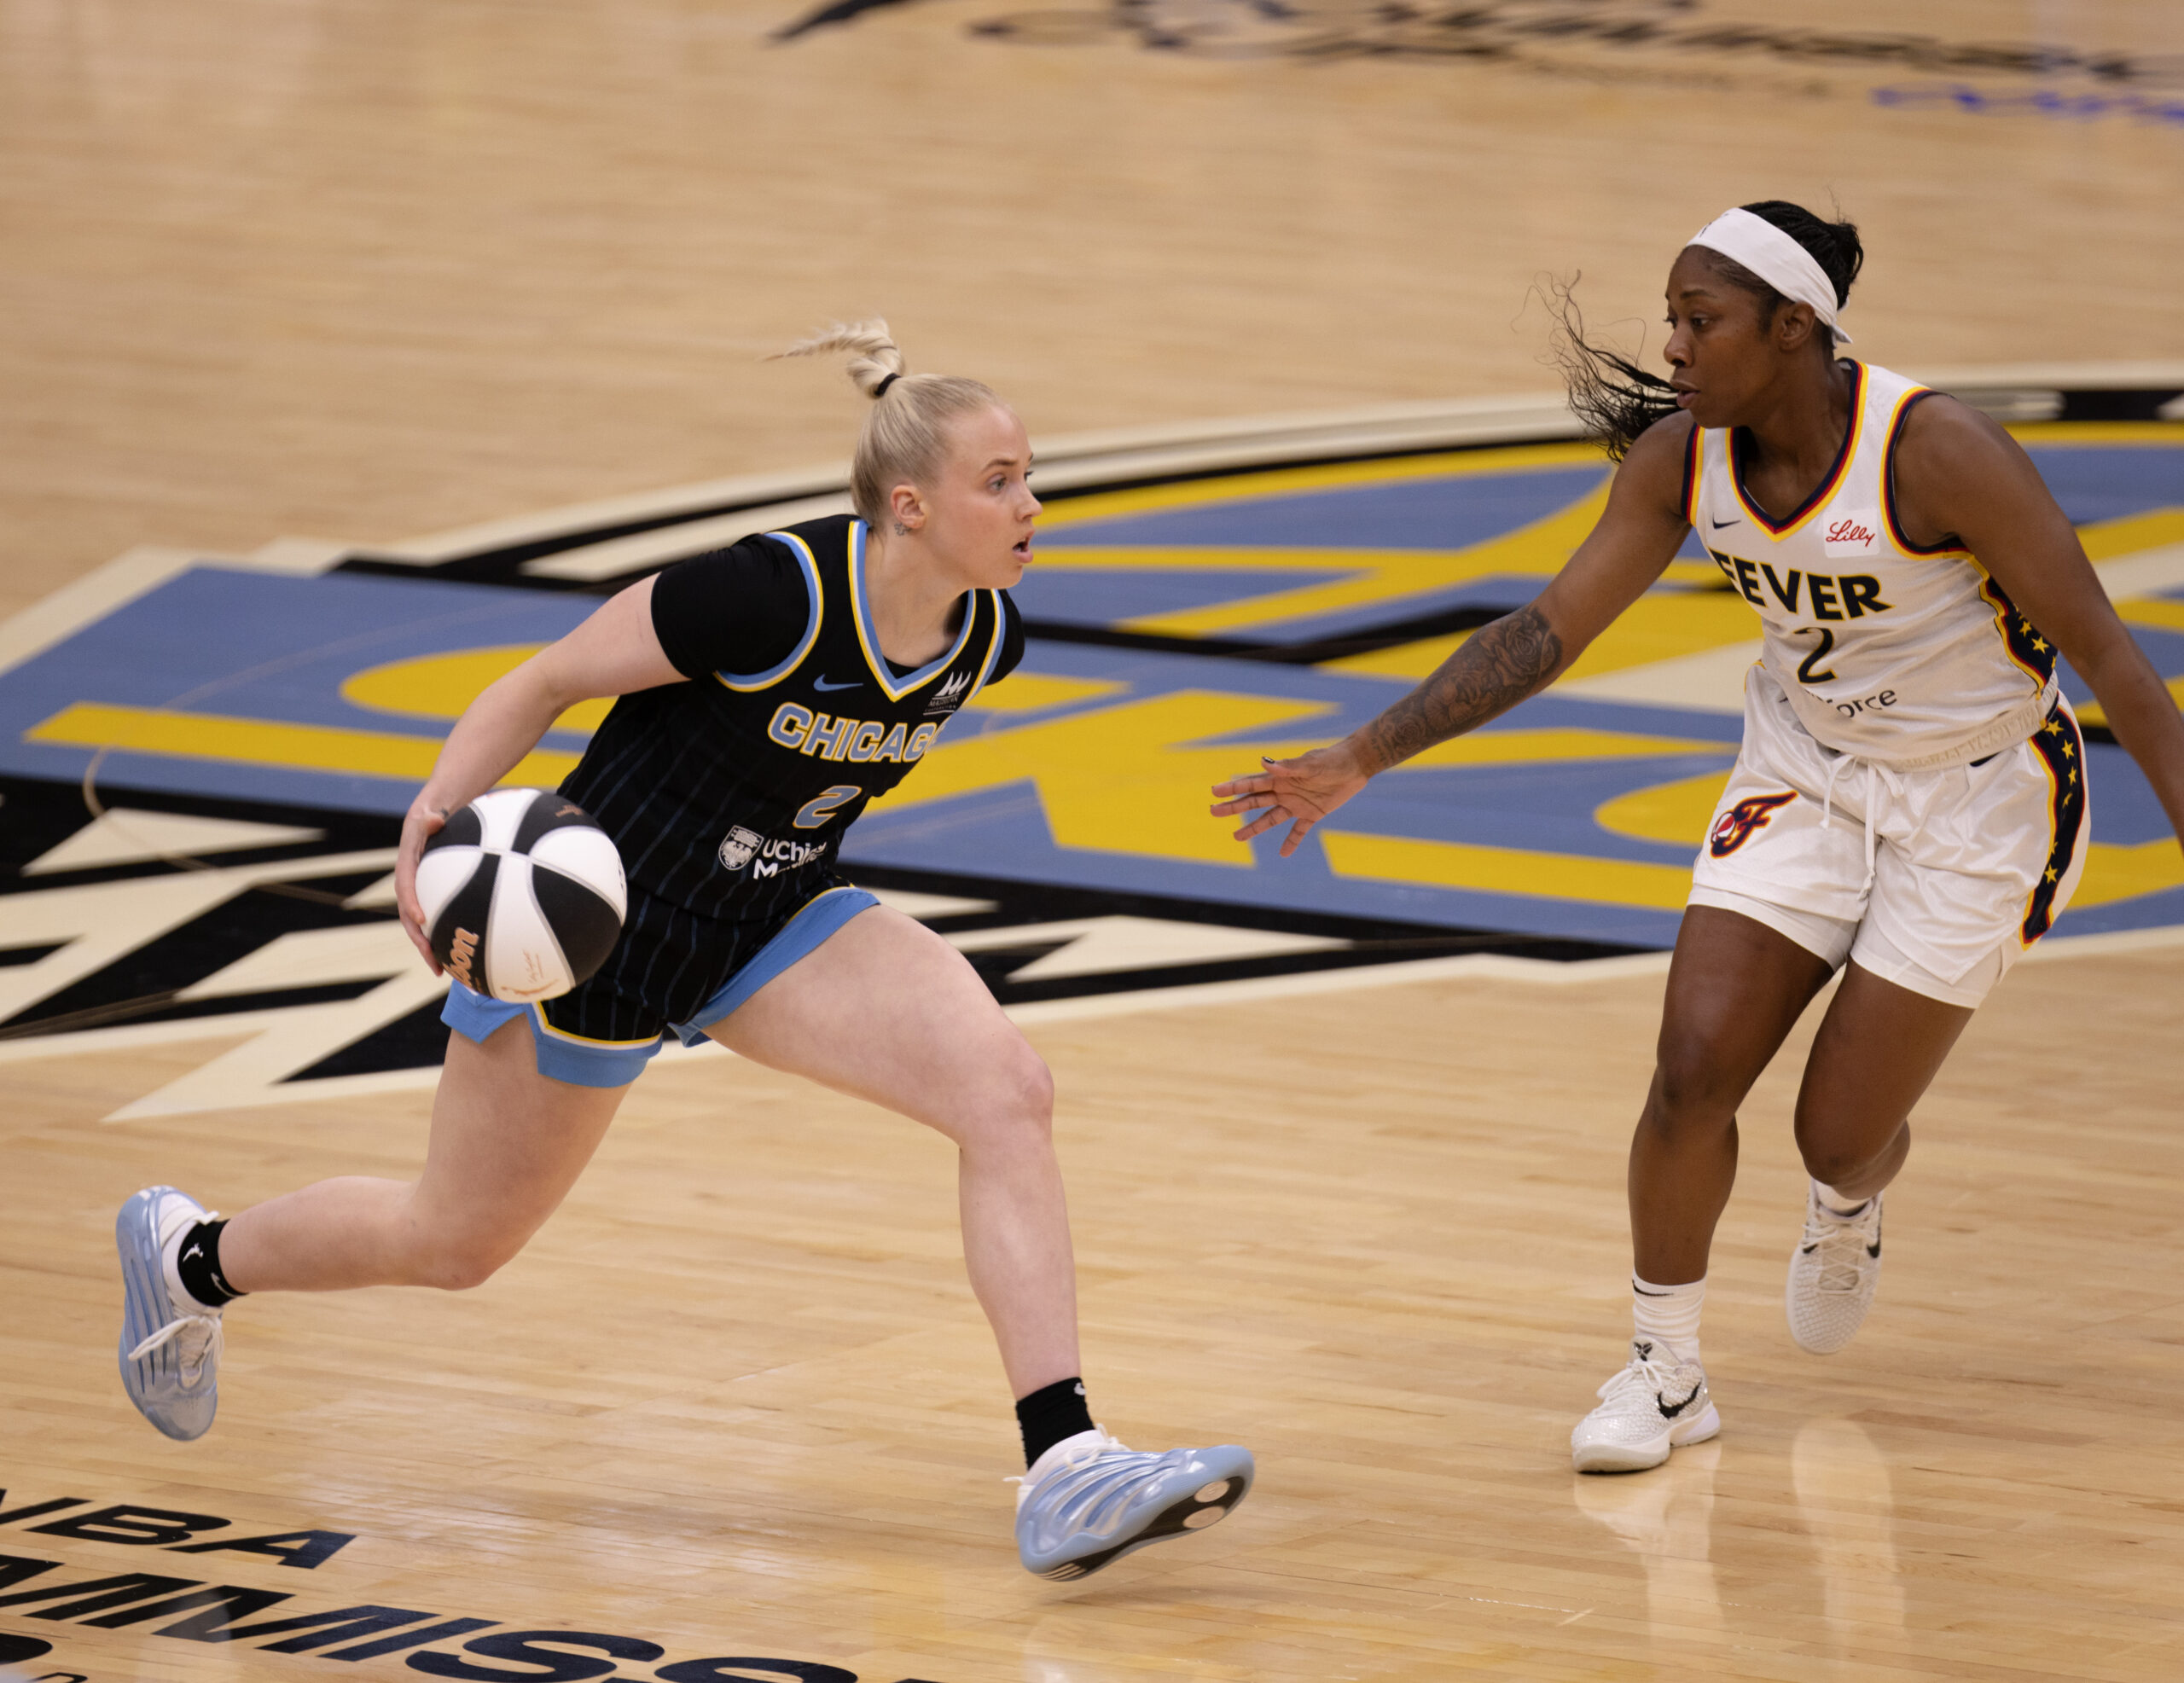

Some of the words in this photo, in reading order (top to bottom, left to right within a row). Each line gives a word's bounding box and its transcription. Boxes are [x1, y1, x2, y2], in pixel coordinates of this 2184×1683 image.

[1826, 519, 1875, 548] Lilly
[1708, 547, 1895, 621] FEVER
[1793, 627, 1838, 684] 2
[768, 702, 945, 763] CHICAG
[793, 785, 862, 829] 2
